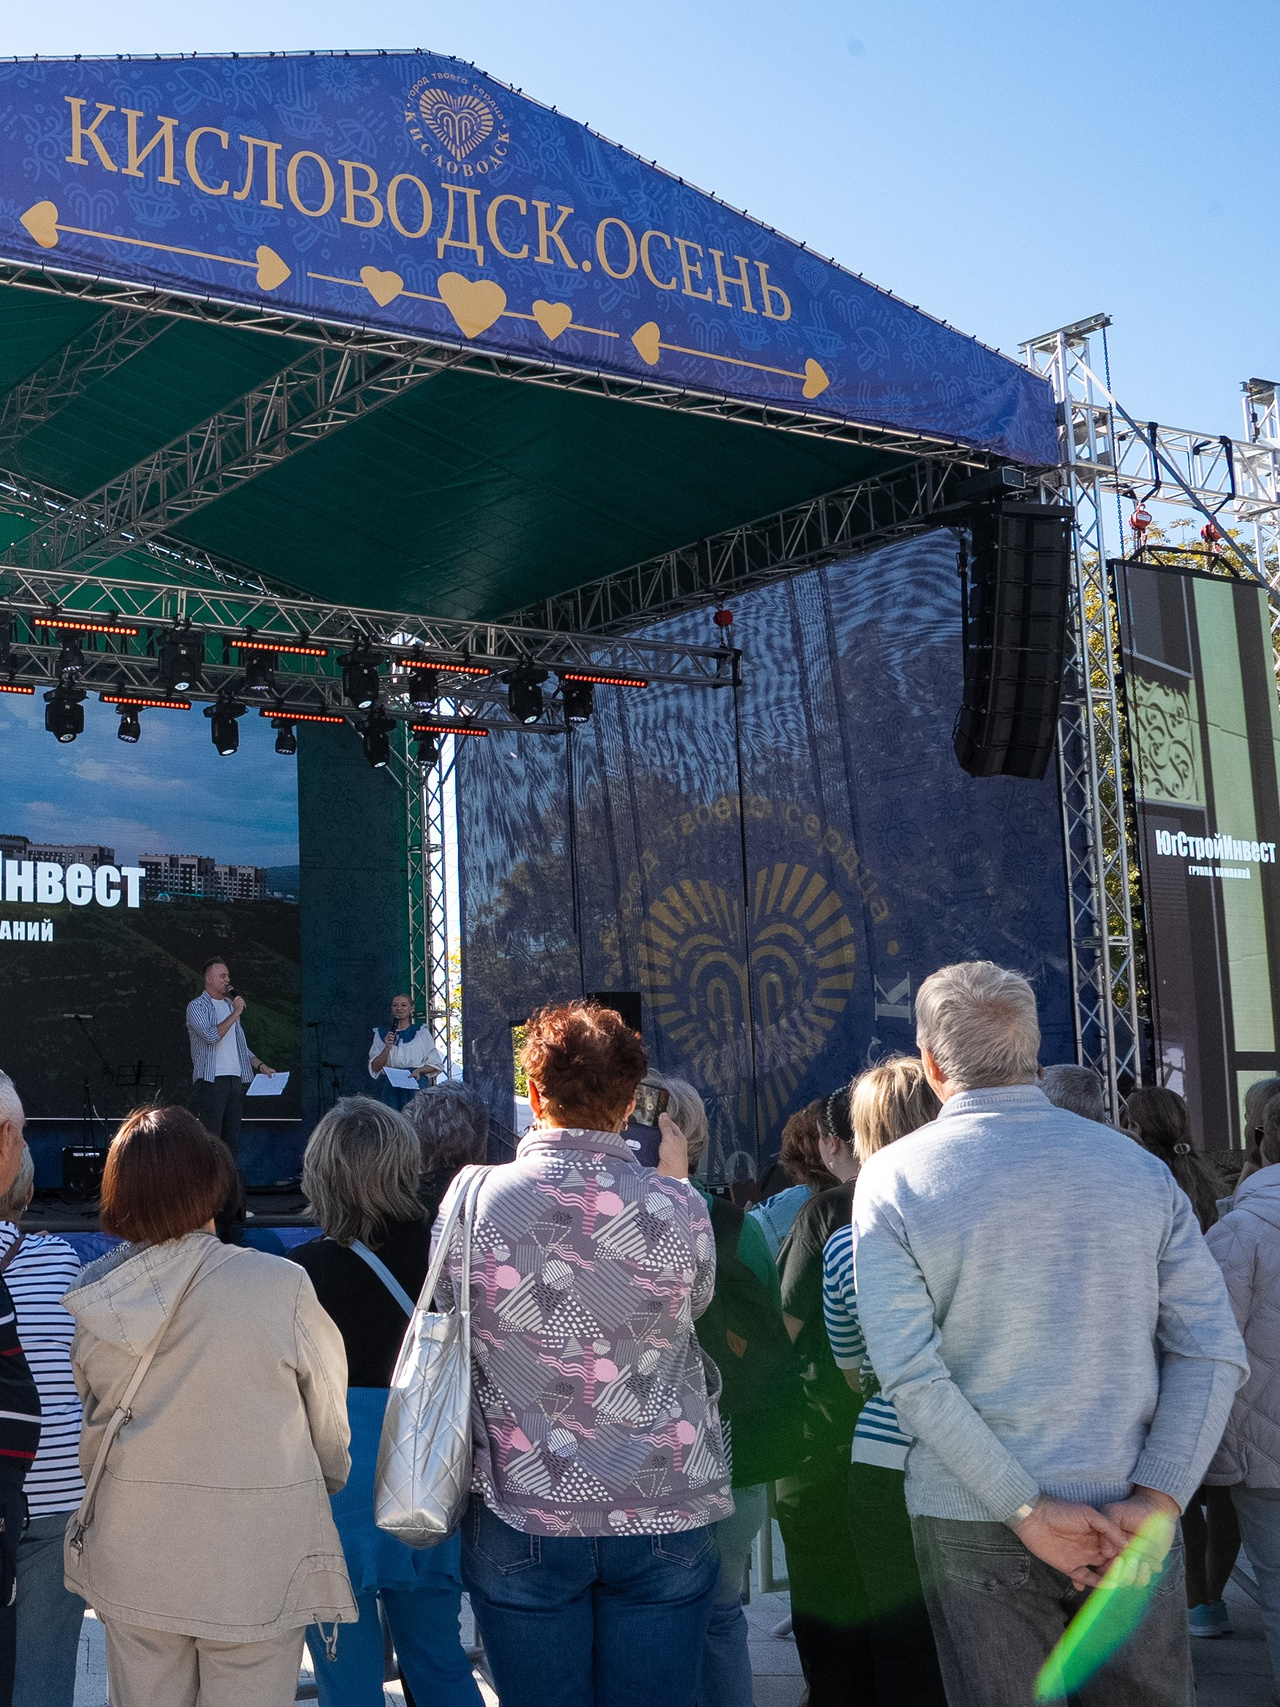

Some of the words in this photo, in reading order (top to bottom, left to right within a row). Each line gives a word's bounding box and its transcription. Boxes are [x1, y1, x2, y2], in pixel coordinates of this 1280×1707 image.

[407, 76, 430, 101] город
[431, 72, 468, 85] твоего
[473, 83, 505, 121] сердца
[404, 111, 511, 177] КИСЛОВОДСК
[64, 95, 793, 322] КИСЛОВОДСК.ОСЕНЬ
[1155, 829, 1277, 864] ЮгСтройИнвест
